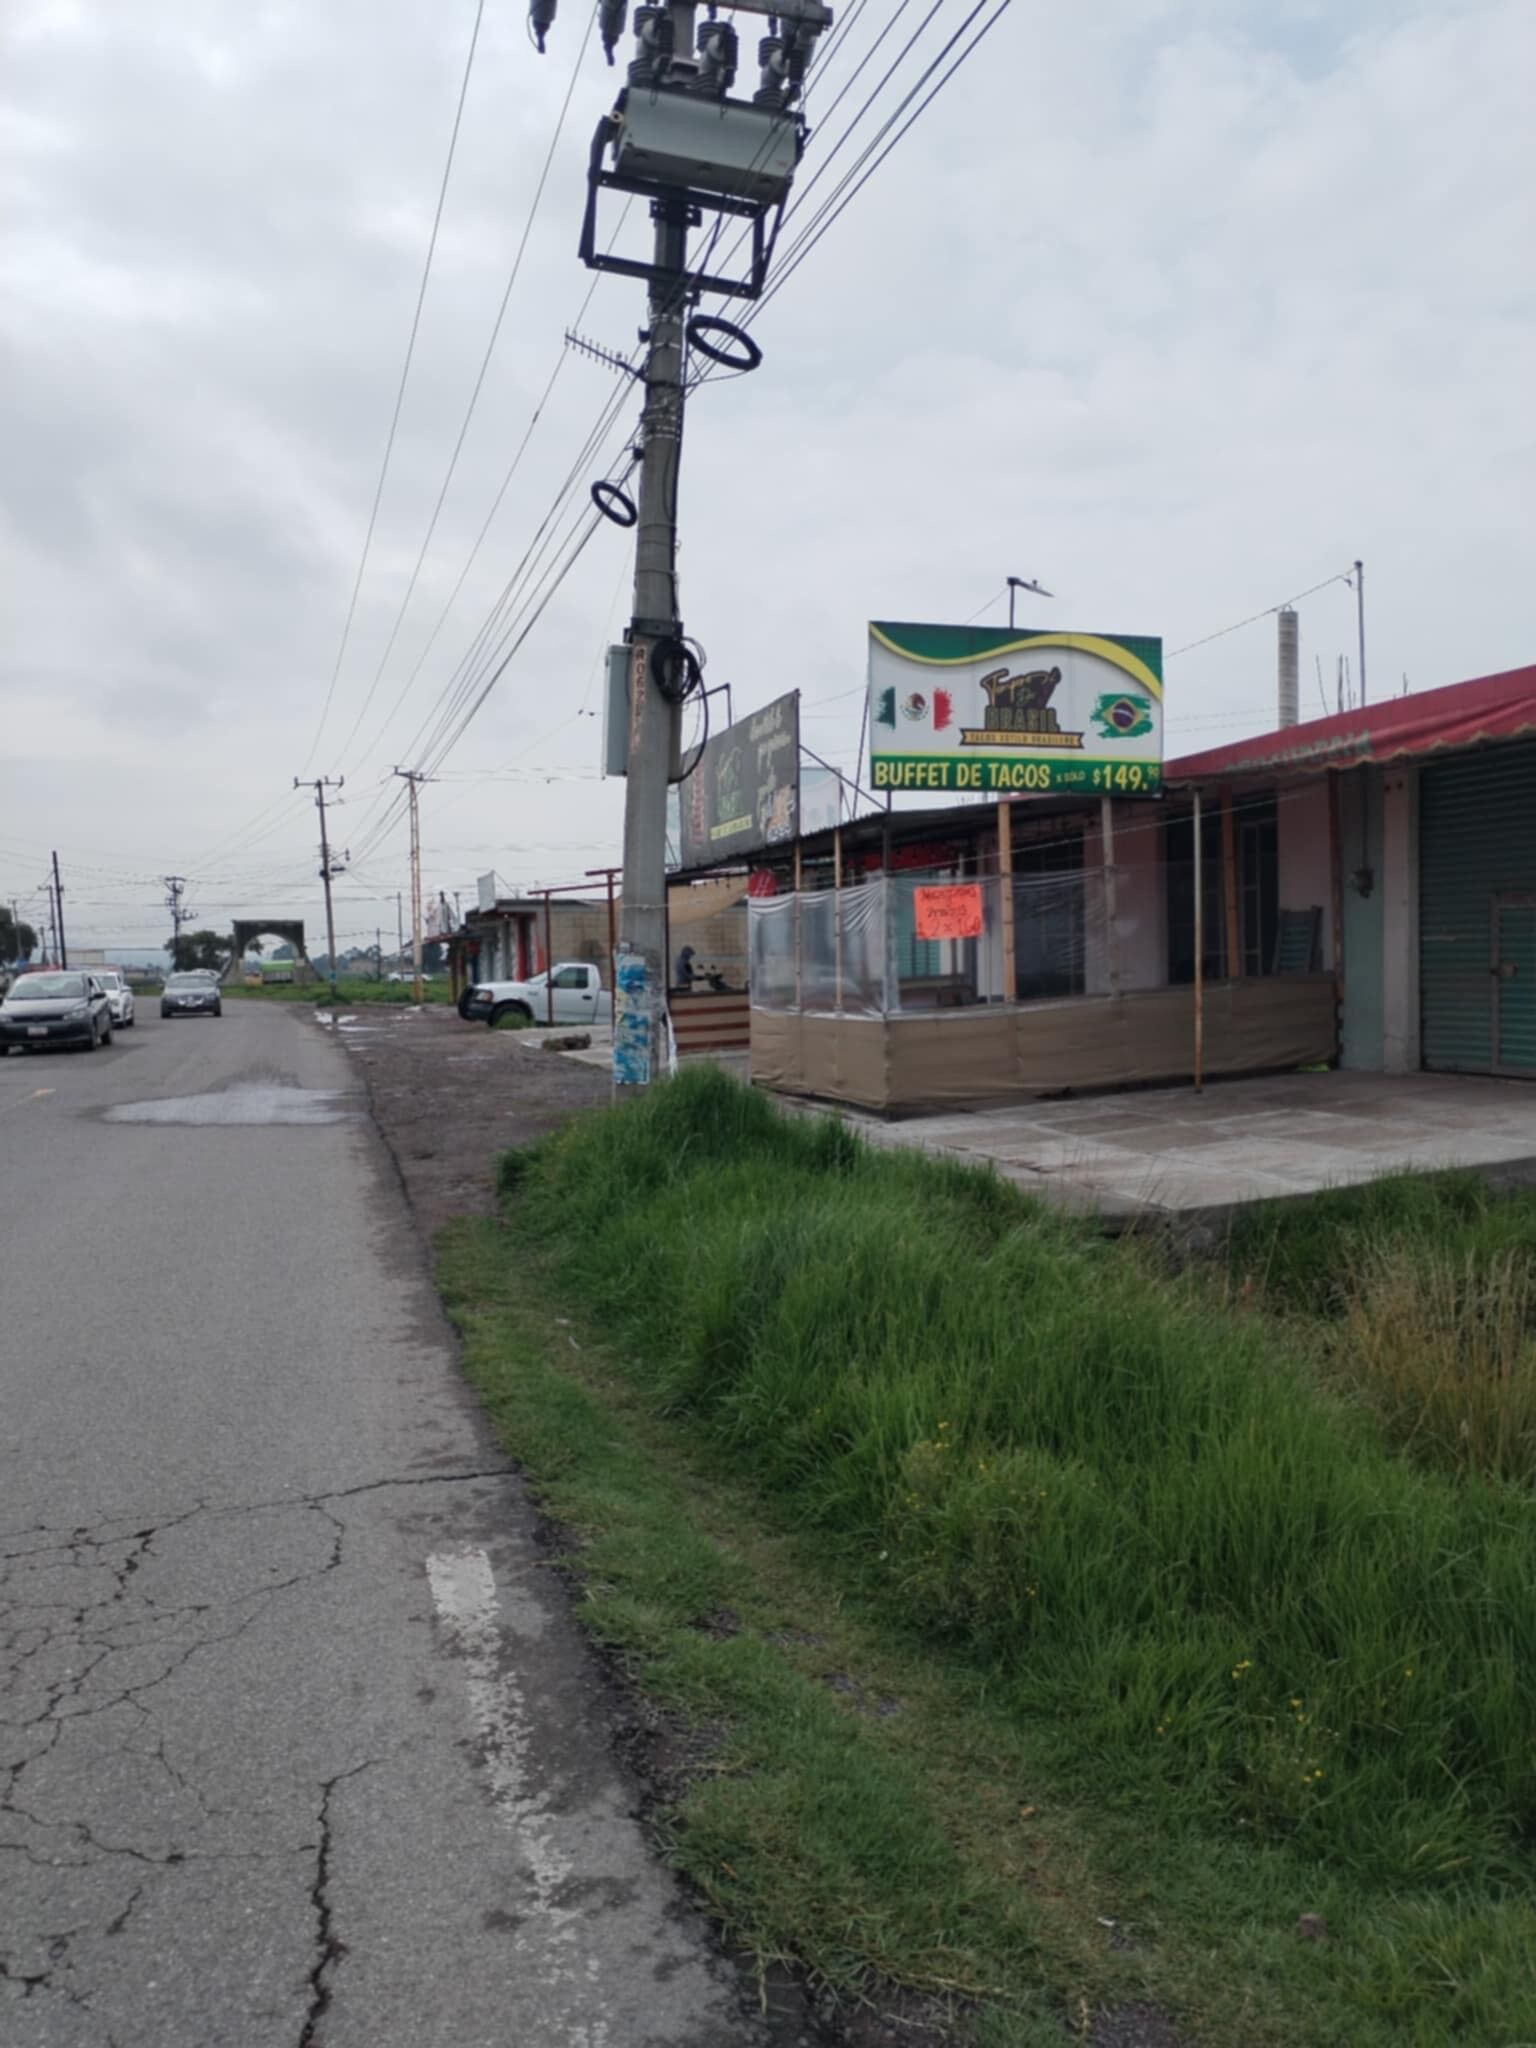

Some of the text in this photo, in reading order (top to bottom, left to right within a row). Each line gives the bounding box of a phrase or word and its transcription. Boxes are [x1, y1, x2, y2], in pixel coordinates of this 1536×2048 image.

[874, 761, 951, 787] BUFFET
[956, 762, 982, 788] DE
[987, 763, 1051, 788] TACOS
